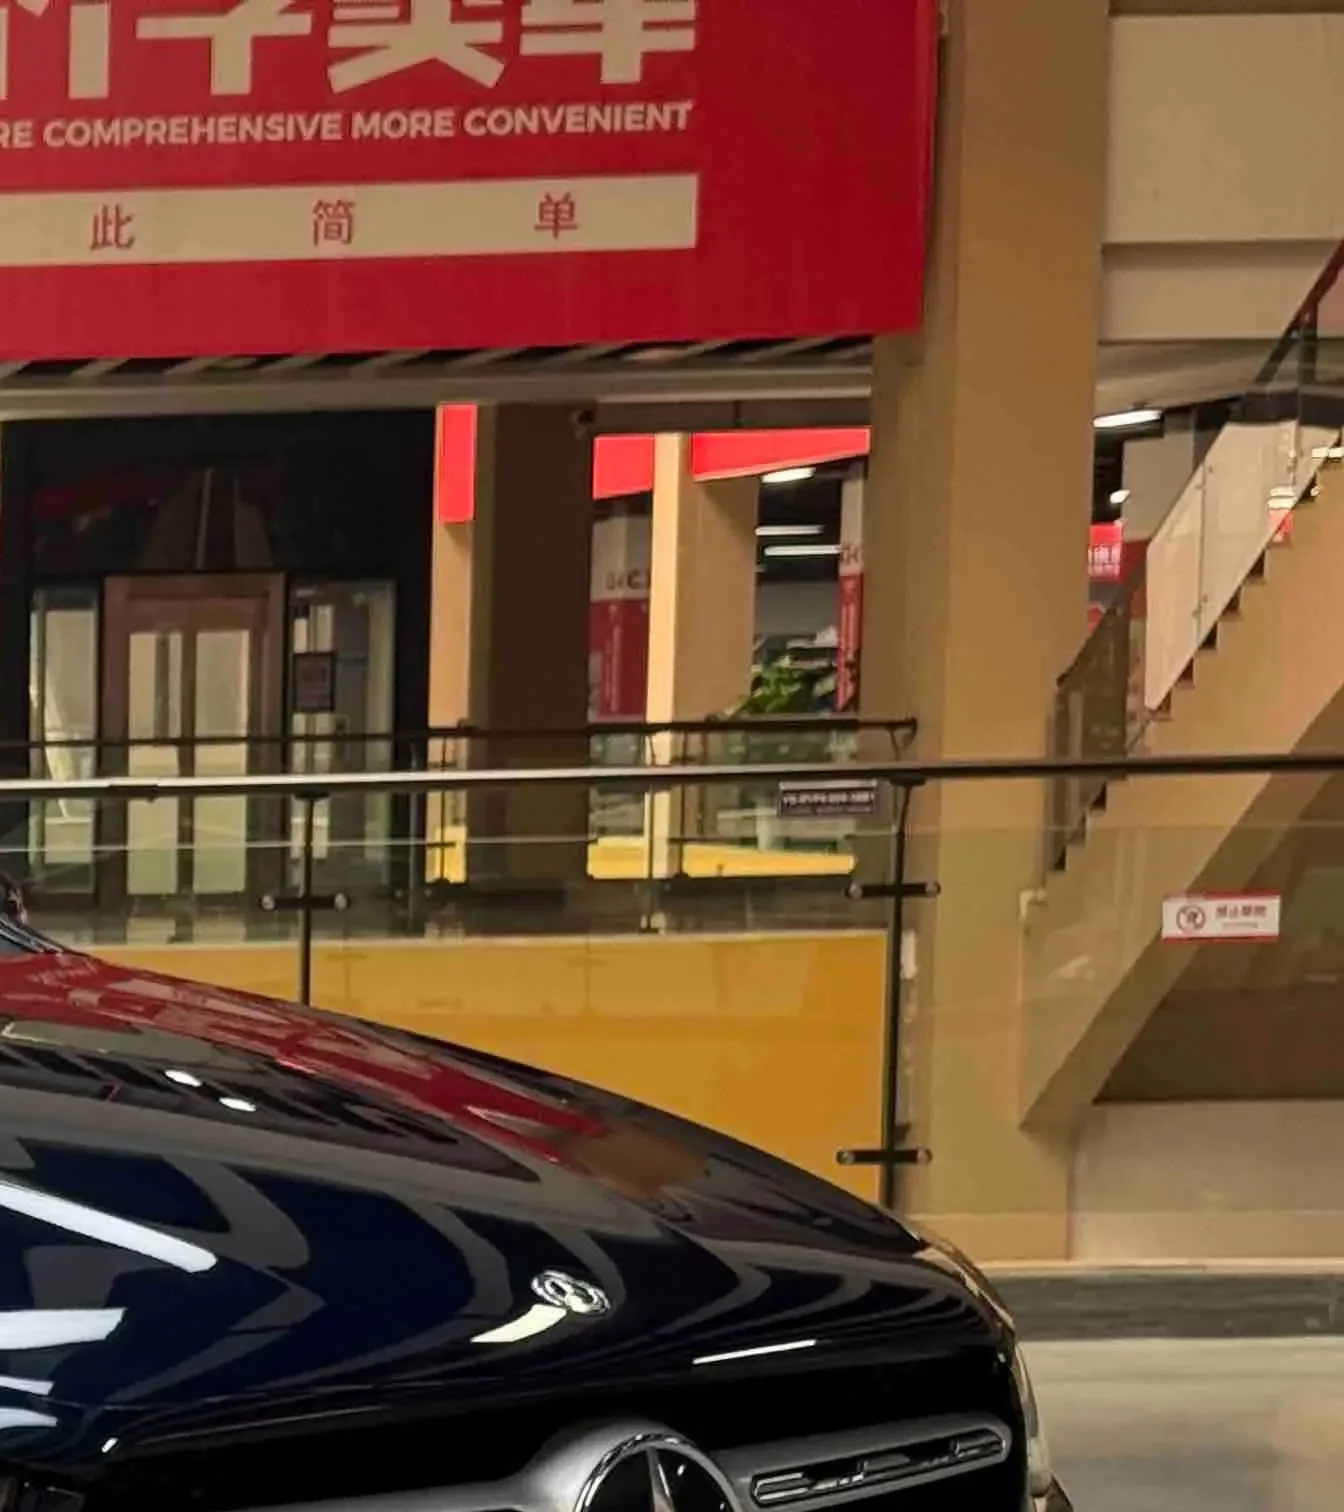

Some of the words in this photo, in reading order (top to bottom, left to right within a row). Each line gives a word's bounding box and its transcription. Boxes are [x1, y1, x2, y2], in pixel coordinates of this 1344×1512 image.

[43, 114, 342, 147] COMPREHENSIVE
[351, 110, 453, 139] MORE
[464, 102, 693, 136] CONVENIENT
